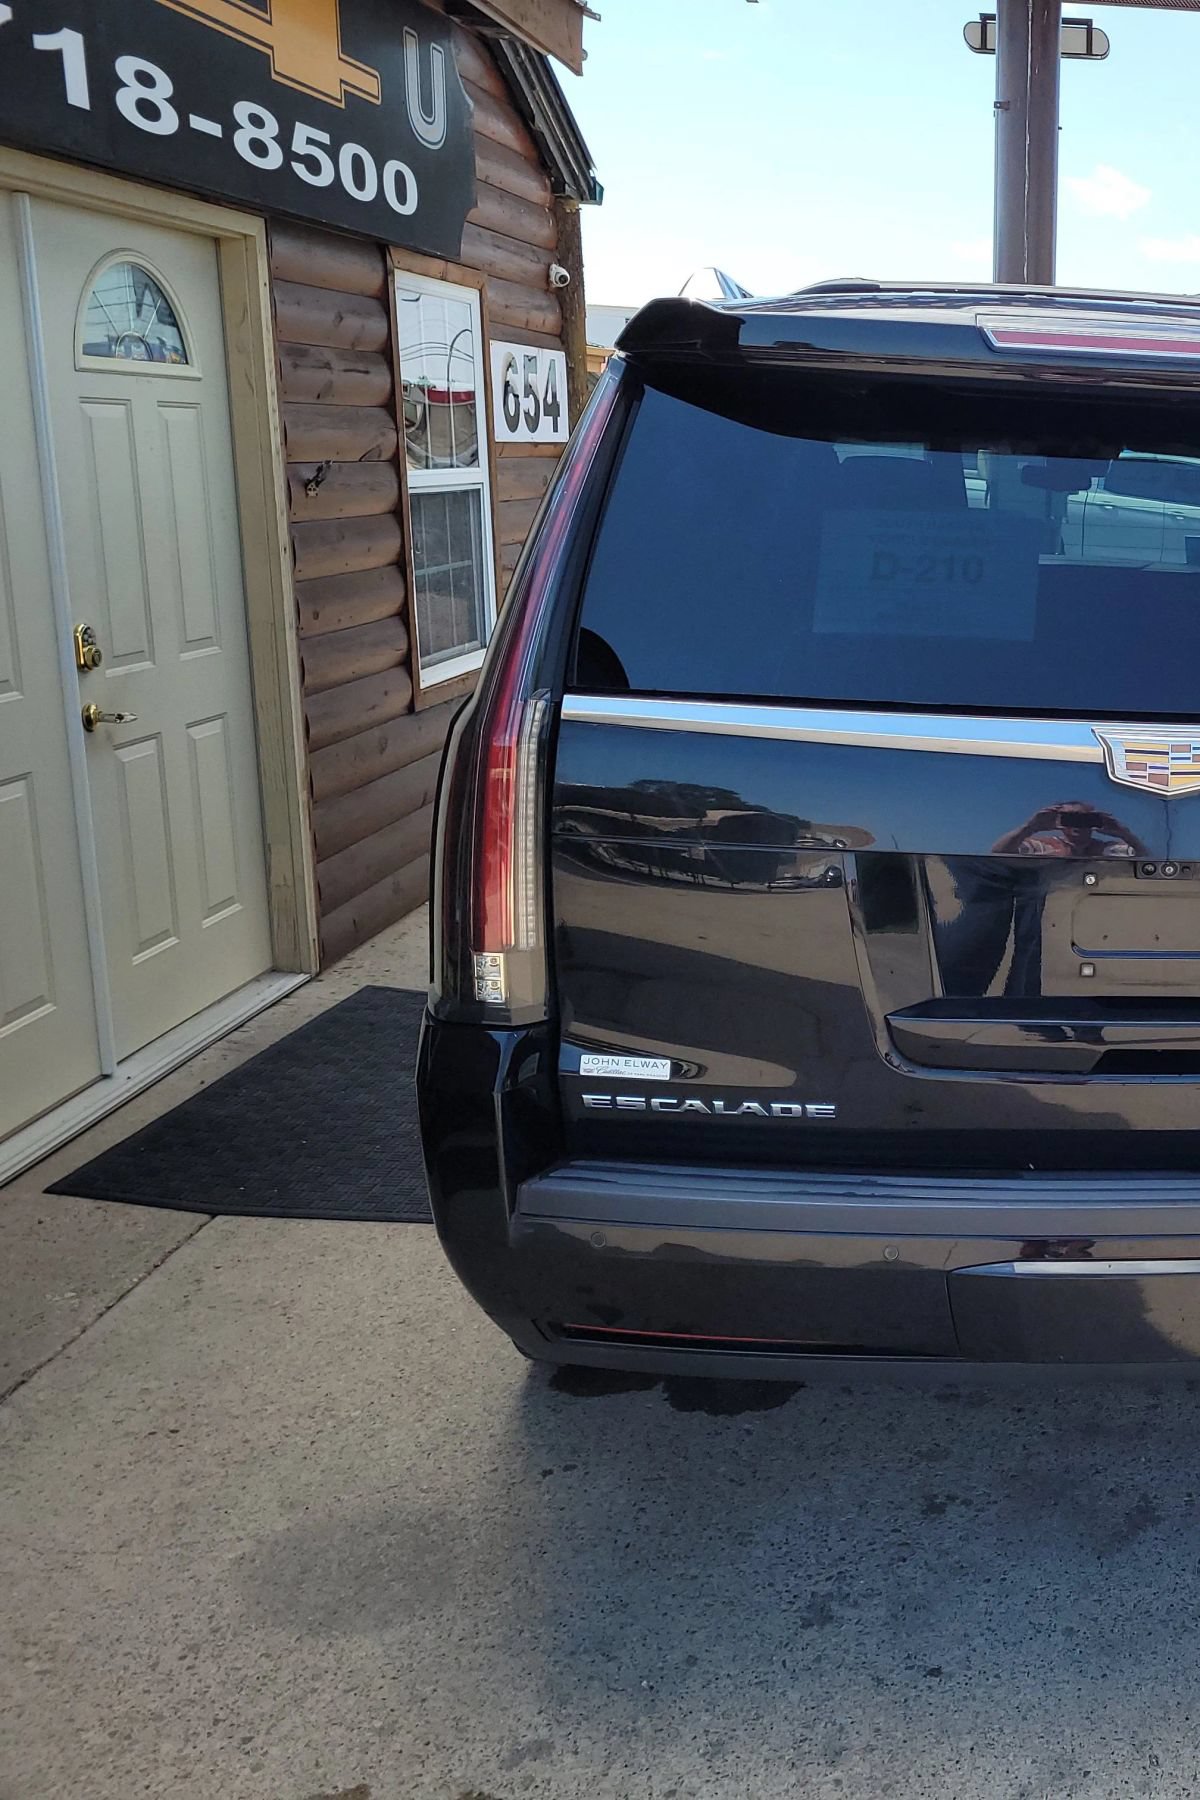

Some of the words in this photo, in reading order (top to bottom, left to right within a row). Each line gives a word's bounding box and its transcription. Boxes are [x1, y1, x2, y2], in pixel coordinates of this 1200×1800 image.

[0, 3, 418, 216] 18-8500
[403, 26, 447, 150] U
[501, 352, 560, 433] 654
[870, 551, 984, 584] D-210
[583, 1057, 620, 1066] JOHN
[624, 1060, 668, 1069] ELWAY
[582, 1095, 835, 1118] ESCALADE
